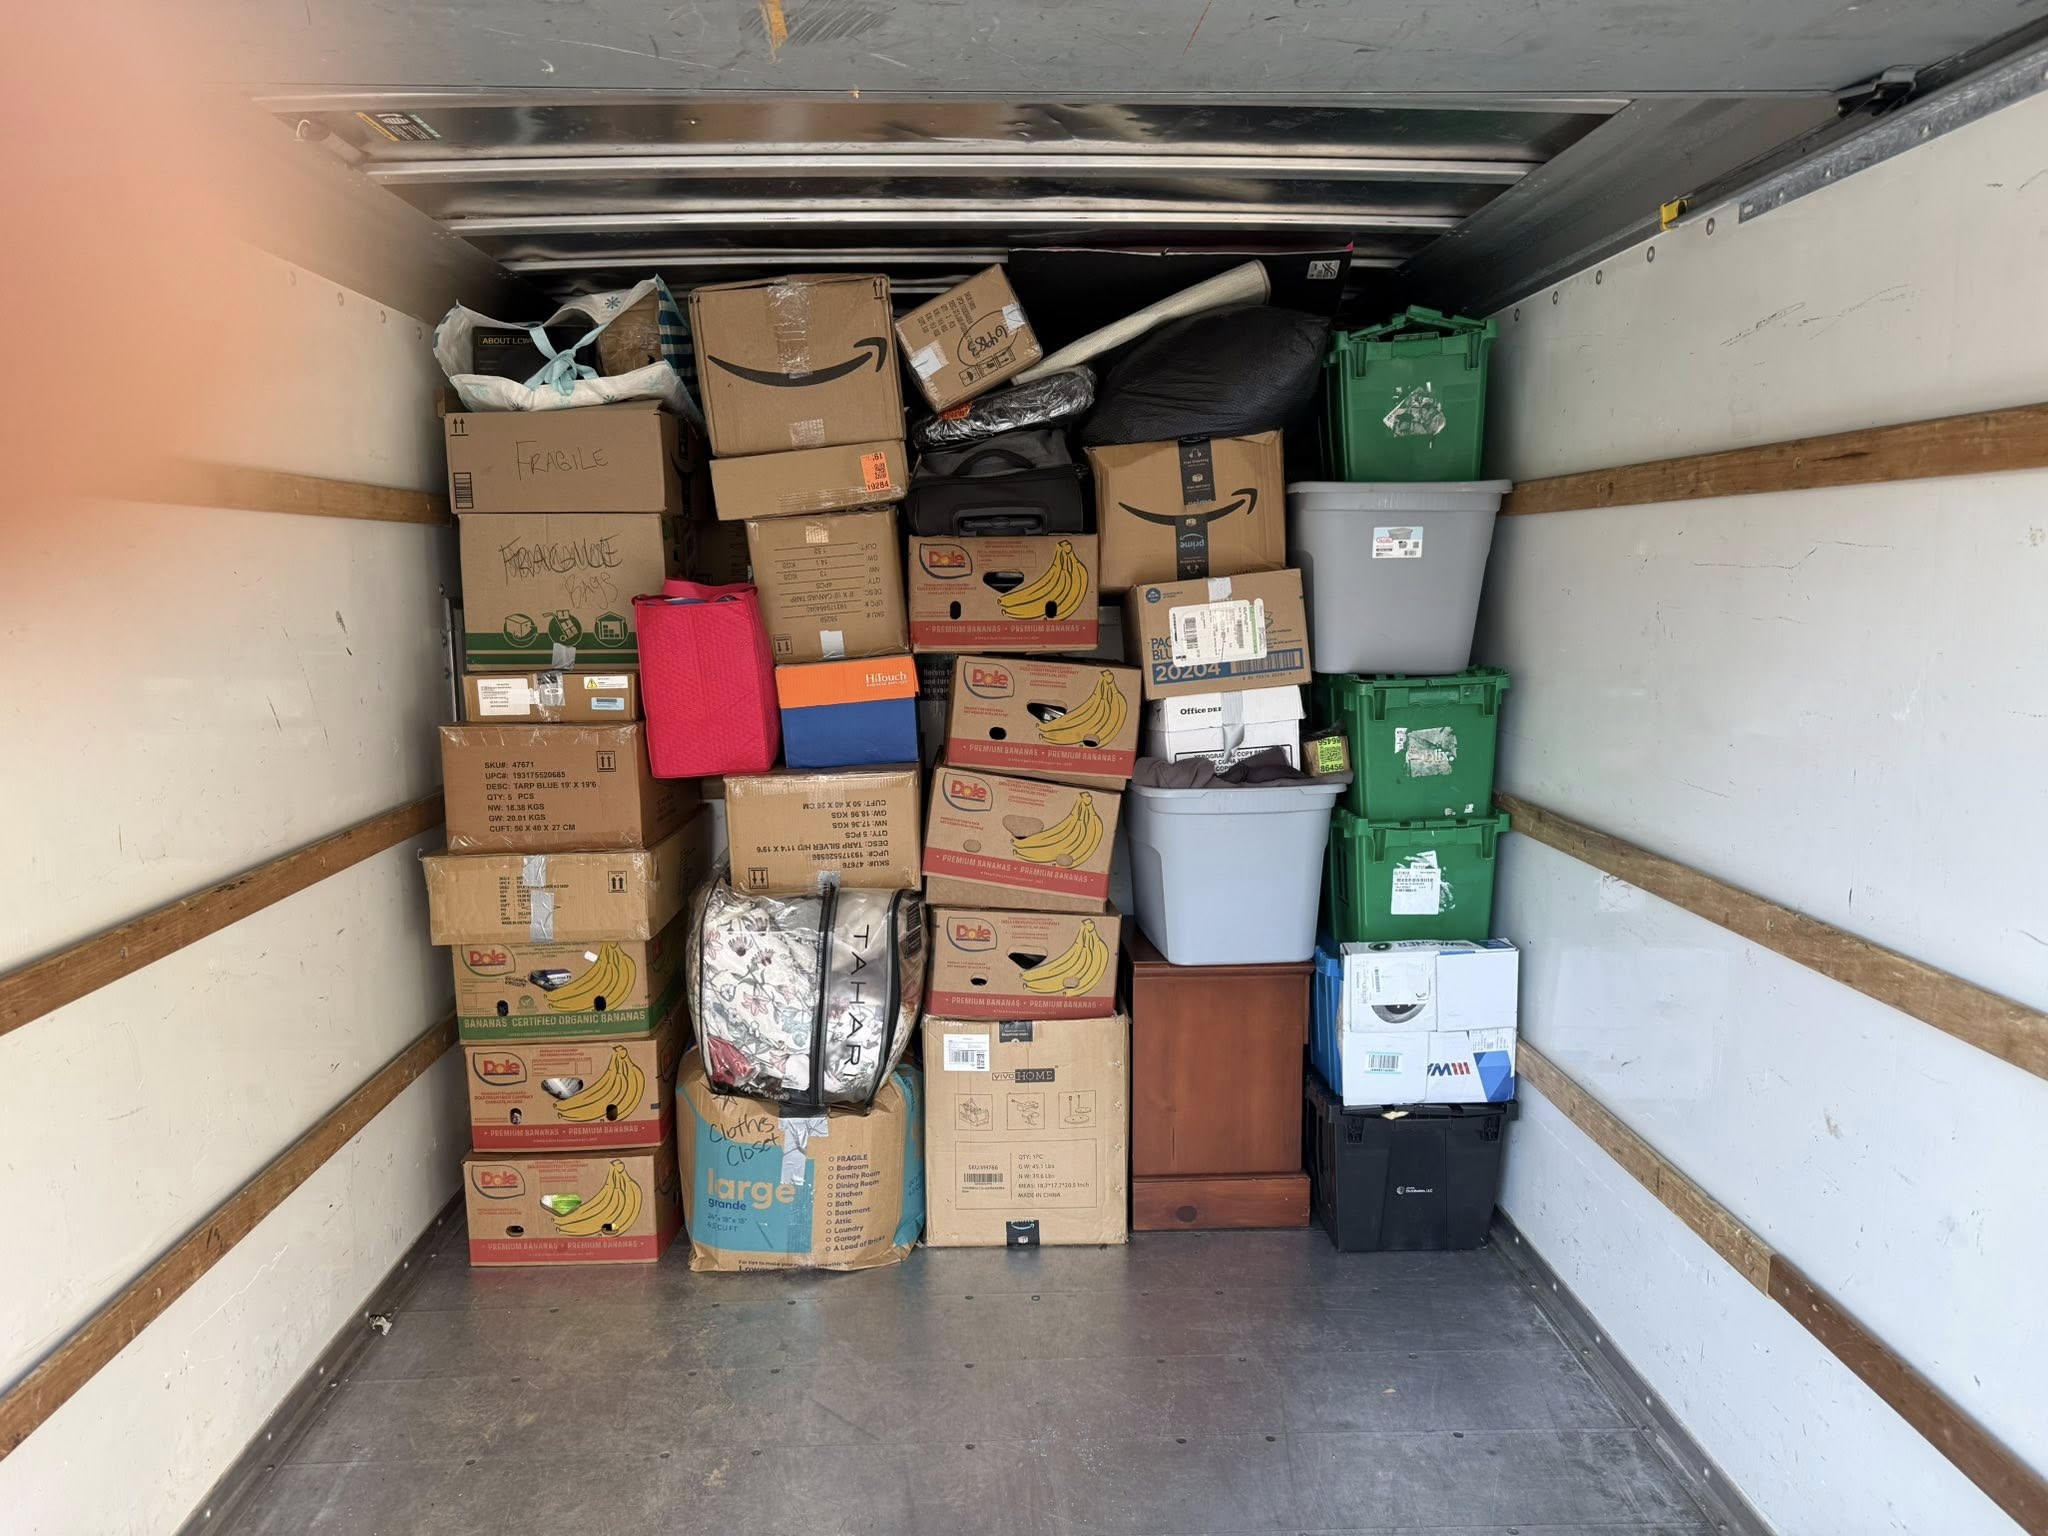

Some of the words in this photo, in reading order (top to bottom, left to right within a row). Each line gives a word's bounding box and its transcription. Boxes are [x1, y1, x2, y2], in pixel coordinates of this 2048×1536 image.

[515, 440, 609, 480] FRAGILE
[867, 480, 889, 490] 19284
[1180, 539, 1205, 551] prime
[928, 551, 966, 566] Dole
[931, 625, 966, 633] PREMIUM
[967, 624, 1001, 633] BANANAS
[1011, 624, 1044, 632] PREMIUM
[1045, 624, 1080, 632] BANANAS
[1155, 661, 1221, 682] 20204
[865, 670, 907, 684] HiTouch
[971, 668, 1009, 686] Dole
[1180, 707, 1206, 715] Office
[969, 744, 1002, 753] PREMIUM
[1002, 747, 1038, 756] BANANAS
[1047, 750, 1081, 760] PREMIUM
[1082, 753, 1117, 762] BANANAS
[1320, 764, 1344, 773] 86456
[514, 782, 535, 790] TARP
[536, 781, 558, 789] BLUE
[950, 780, 987, 799] Dole
[487, 793, 505, 801] QTY:
[527, 803, 545, 811] KGS
[802, 802, 815, 810] CM
[863, 799, 887, 807] CUFT:
[872, 819, 888, 827] NW:
[845, 831, 862, 839] PCS
[813, 842, 841, 851] SILVER
[842, 841, 862, 849] TARP
[866, 859, 890, 867] SKU#:
[942, 854, 976, 866] PREMIUM
[977, 860, 1011, 871] BANANAS
[1019, 866, 1054, 878] PREMIUM
[1054, 871, 1088, 883] BANANAS
[955, 924, 992, 940] Dole
[469, 949, 507, 965] Dole
[843, 924, 870, 1077] TAHARI
[951, 996, 985, 1006] PREMIUM
[986, 998, 1020, 1007] BANANAS
[1029, 1000, 1063, 1008] PREMIUM
[1063, 1001, 1097, 1009] BANANAS
[464, 1018, 508, 1028] BANANAS
[512, 1015, 557, 1027] CERTIFIED
[558, 1013, 600, 1025] ORGANIC
[600, 1010, 646, 1022] BANANAS
[483, 1059, 521, 1073] Dole
[490, 1129, 524, 1137] PREMIUM
[525, 1128, 559, 1136] BANANAS
[568, 1127, 603, 1135] PREMIUM
[603, 1125, 639, 1133] BANANAS
[836, 1154, 868, 1162] FRAGILE
[836, 1164, 869, 1172] Bedroom
[481, 1172, 518, 1186] Dole
[836, 1173, 860, 1181] Family
[707, 1168, 796, 1210] large
[836, 1182, 859, 1190] Dining
[708, 1198, 747, 1211] grande
[835, 1200, 853, 1208] Bath
[834, 1207, 871, 1216] Basement
[834, 1225, 864, 1234] Laundry
[834, 1234, 861, 1243] Garage
[488, 1242, 522, 1250] PREMIUM
[523, 1242, 558, 1250] BANANAS
[567, 1241, 602, 1249] PREMIUM
[602, 1240, 638, 1248] BANANAS
[840, 1243, 858, 1251] Load
